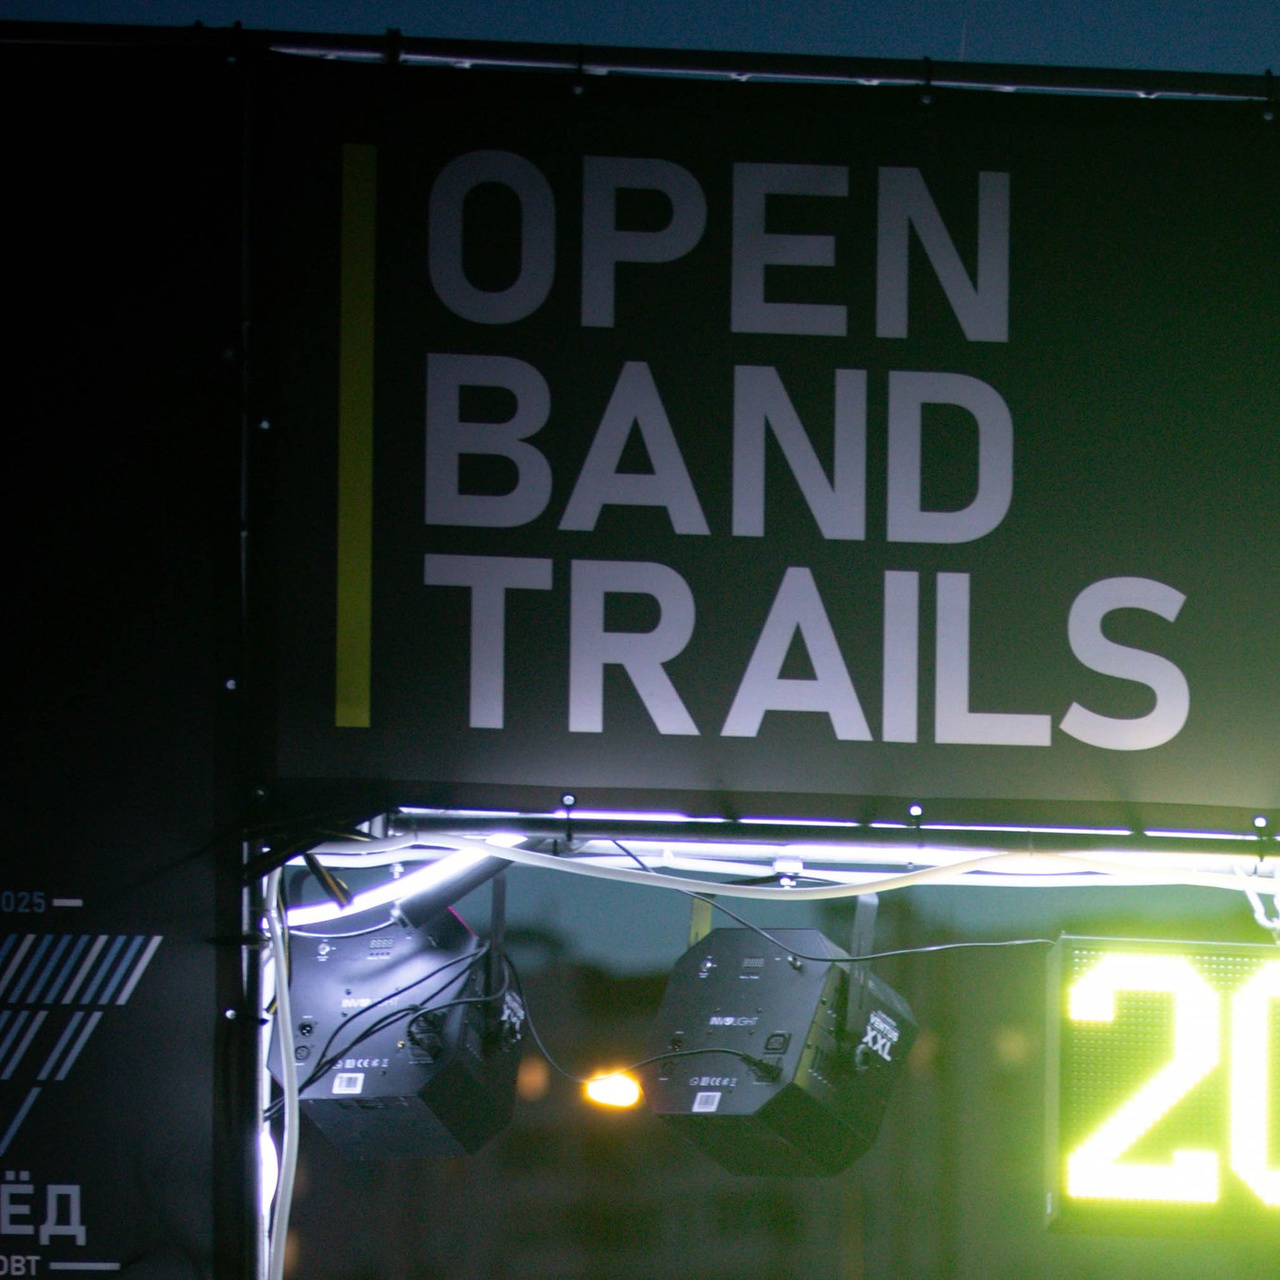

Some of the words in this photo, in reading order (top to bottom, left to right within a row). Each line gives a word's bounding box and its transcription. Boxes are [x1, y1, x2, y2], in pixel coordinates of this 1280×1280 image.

[427, 150, 1011, 342] OPEN
[424, 352, 1015, 545] BAND
[423, 552, 1191, 751] TRAILS
[862, 1024, 892, 1062] XXL
